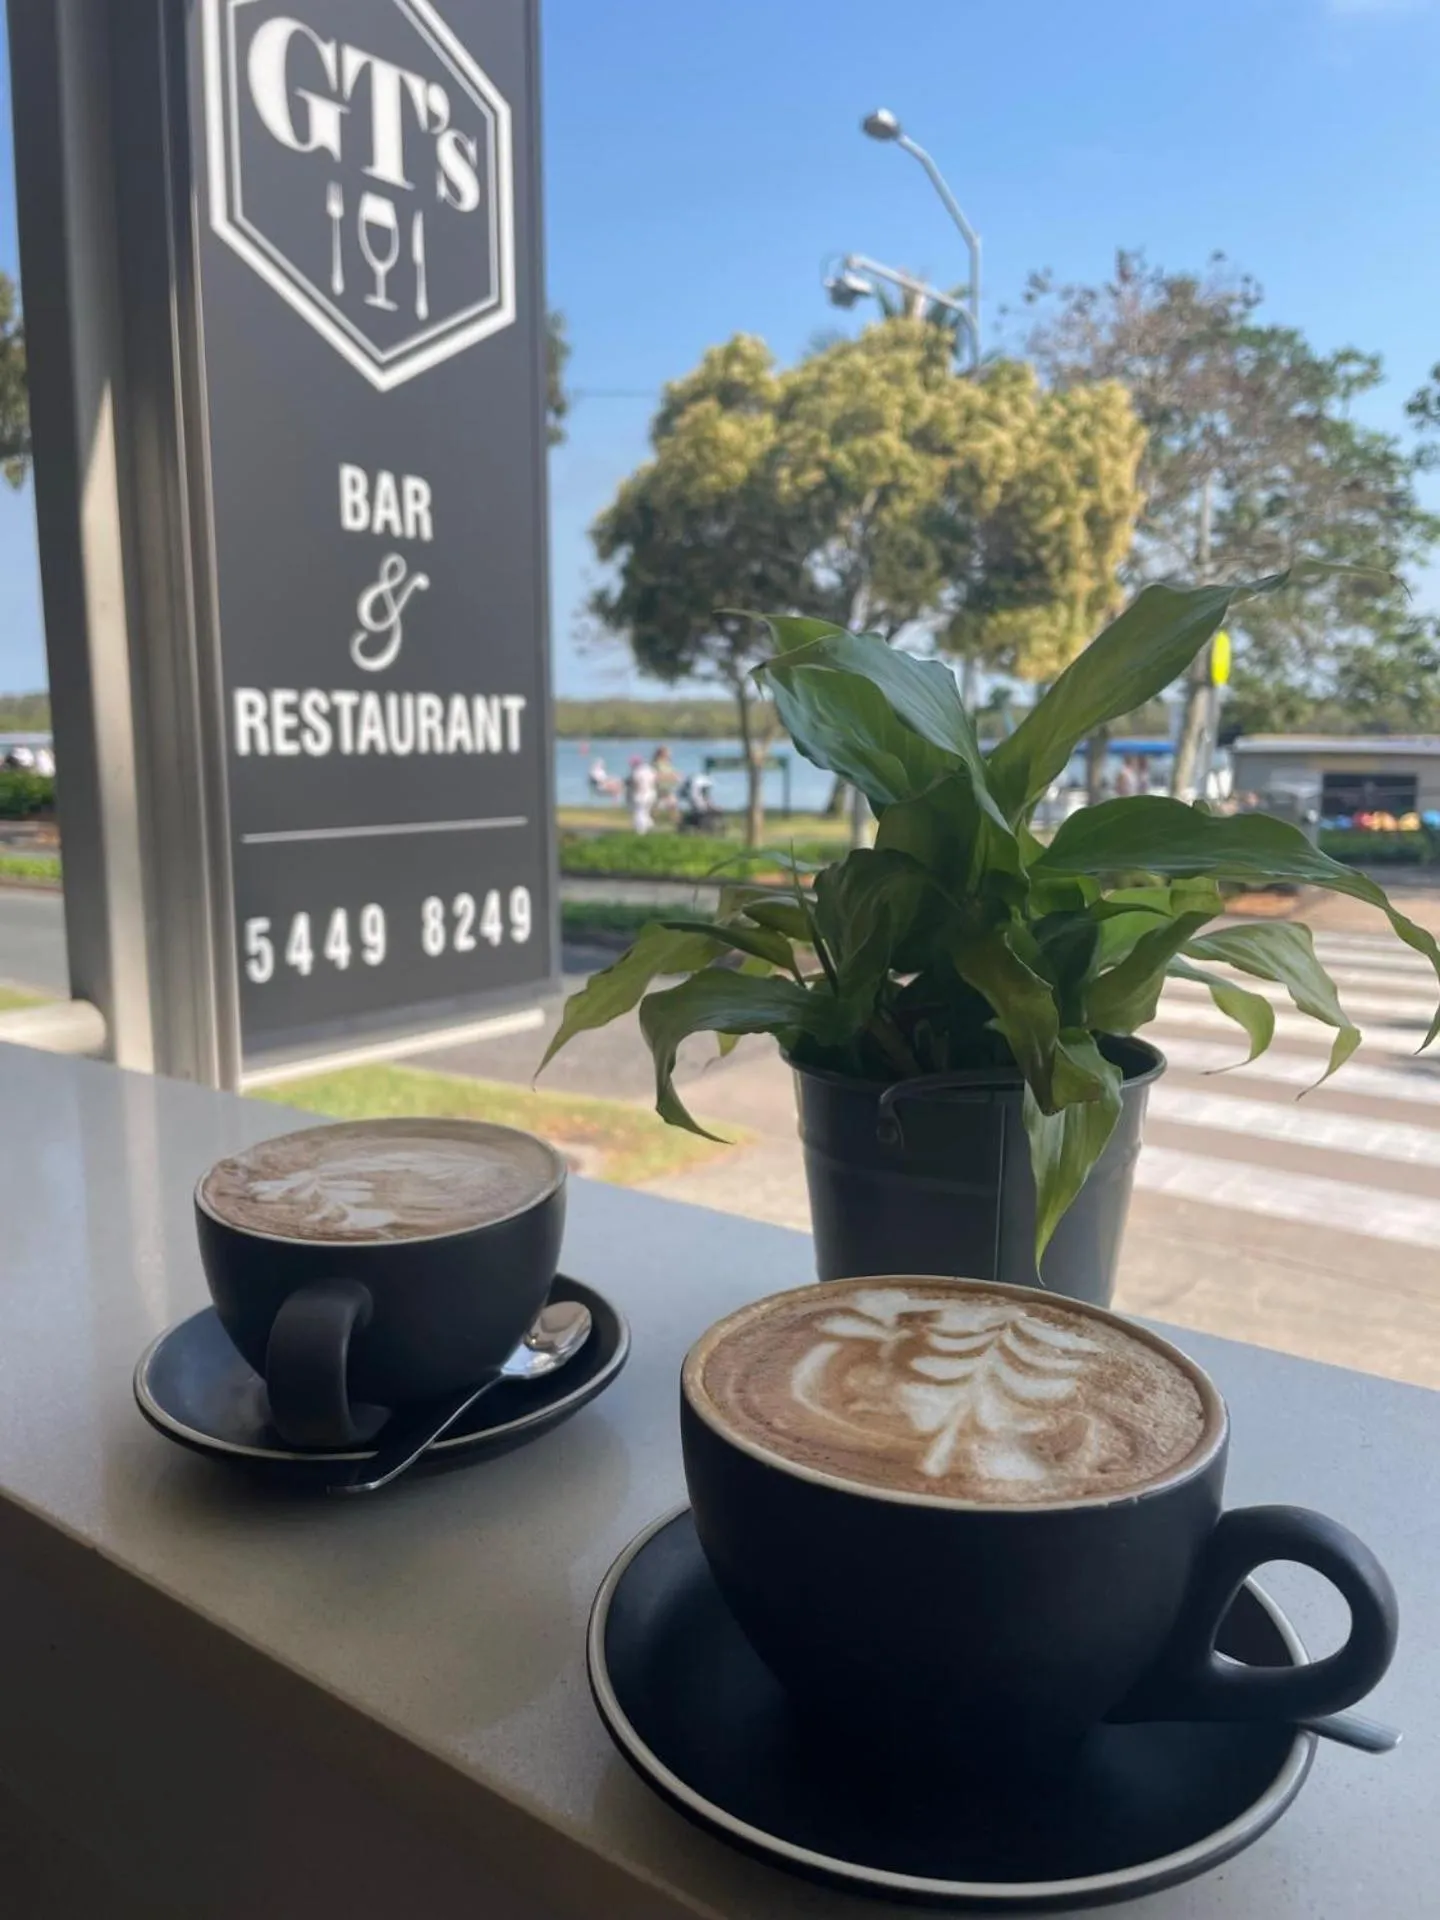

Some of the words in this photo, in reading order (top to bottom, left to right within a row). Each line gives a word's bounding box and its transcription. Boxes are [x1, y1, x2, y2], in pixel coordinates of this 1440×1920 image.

[338, 462, 433, 542] BAR
[350, 552, 430, 672] &
[233, 686, 527, 757] RESTAURANT
[244, 902, 387, 984] 5449
[421, 885, 532, 957] 8249
